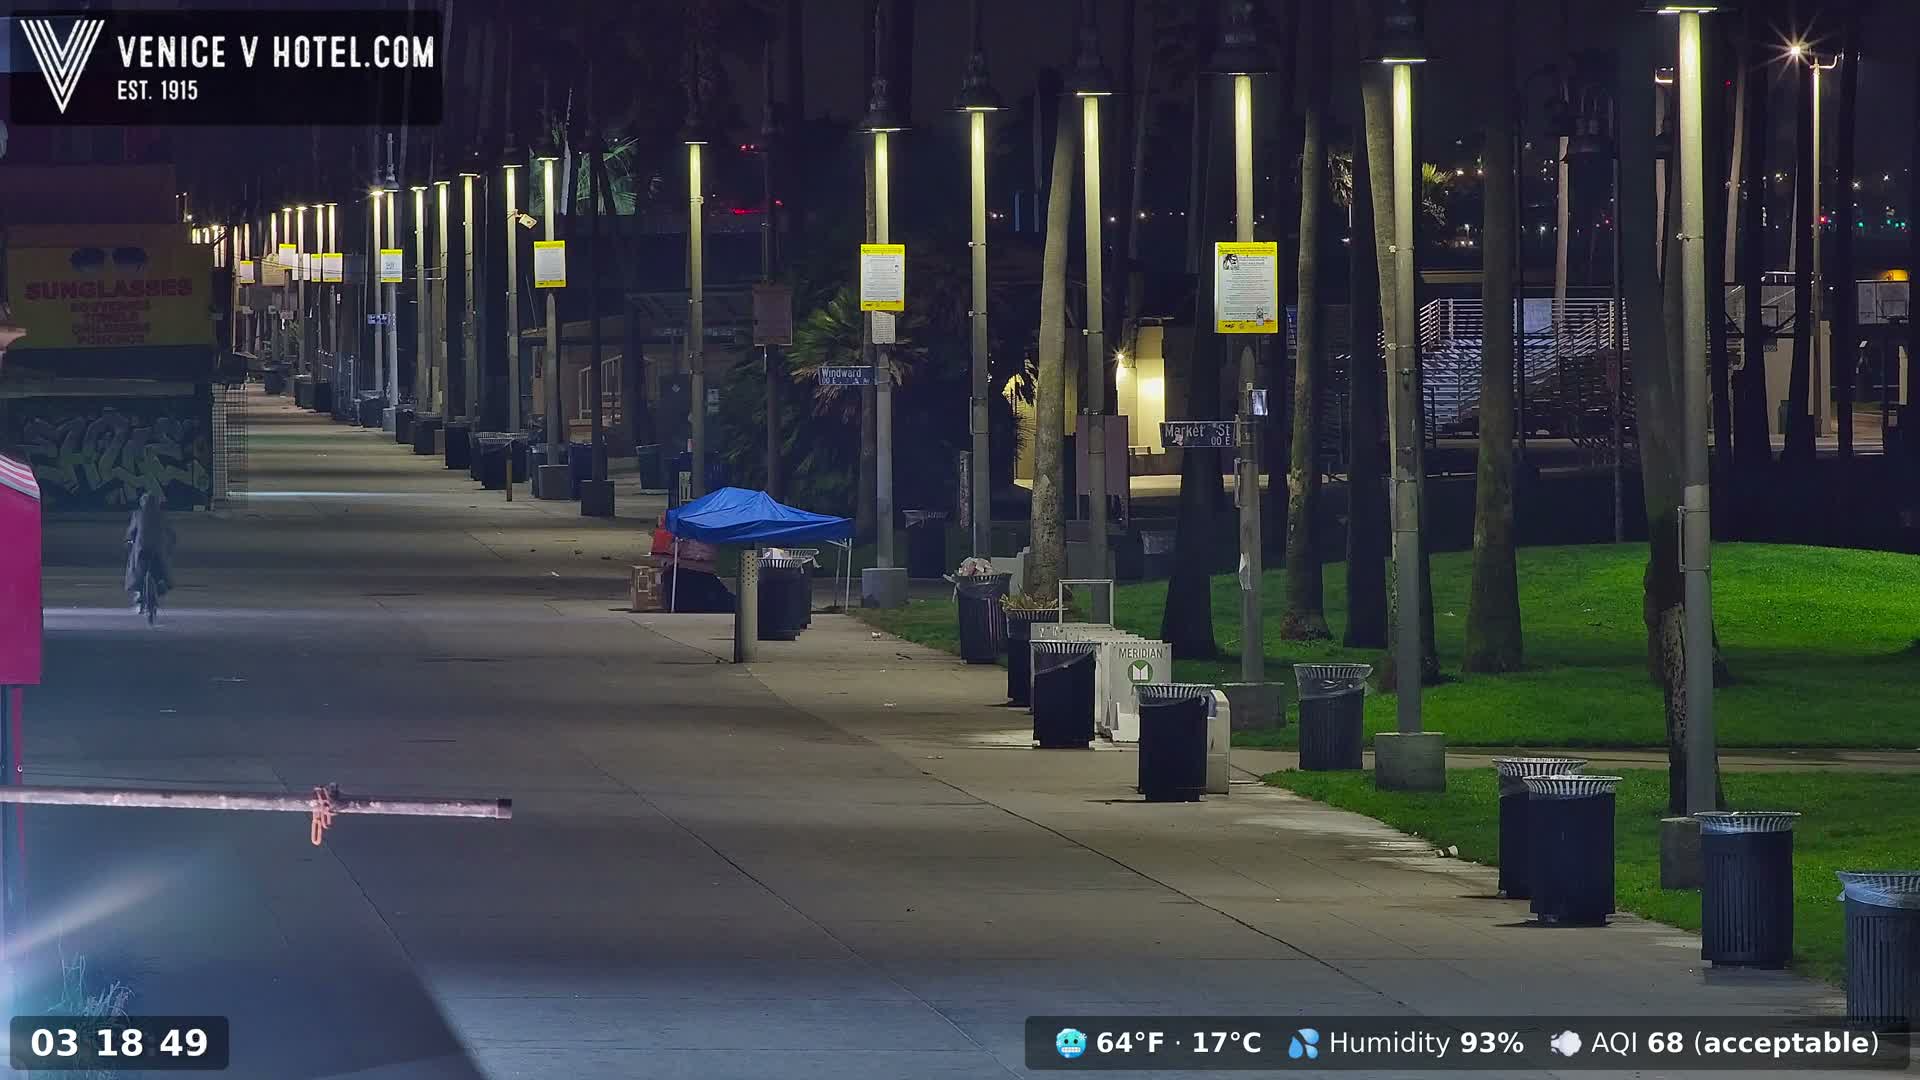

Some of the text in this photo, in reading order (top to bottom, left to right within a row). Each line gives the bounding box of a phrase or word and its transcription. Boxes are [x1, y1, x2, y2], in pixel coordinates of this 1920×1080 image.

[25, 278, 193, 300] SUNGLASSES
[821, 367, 861, 378] Windward
[1165, 424, 1230, 437] Market St
[1225, 437, 1230, 446] E
[1118, 647, 1163, 659] MERIDIAN
